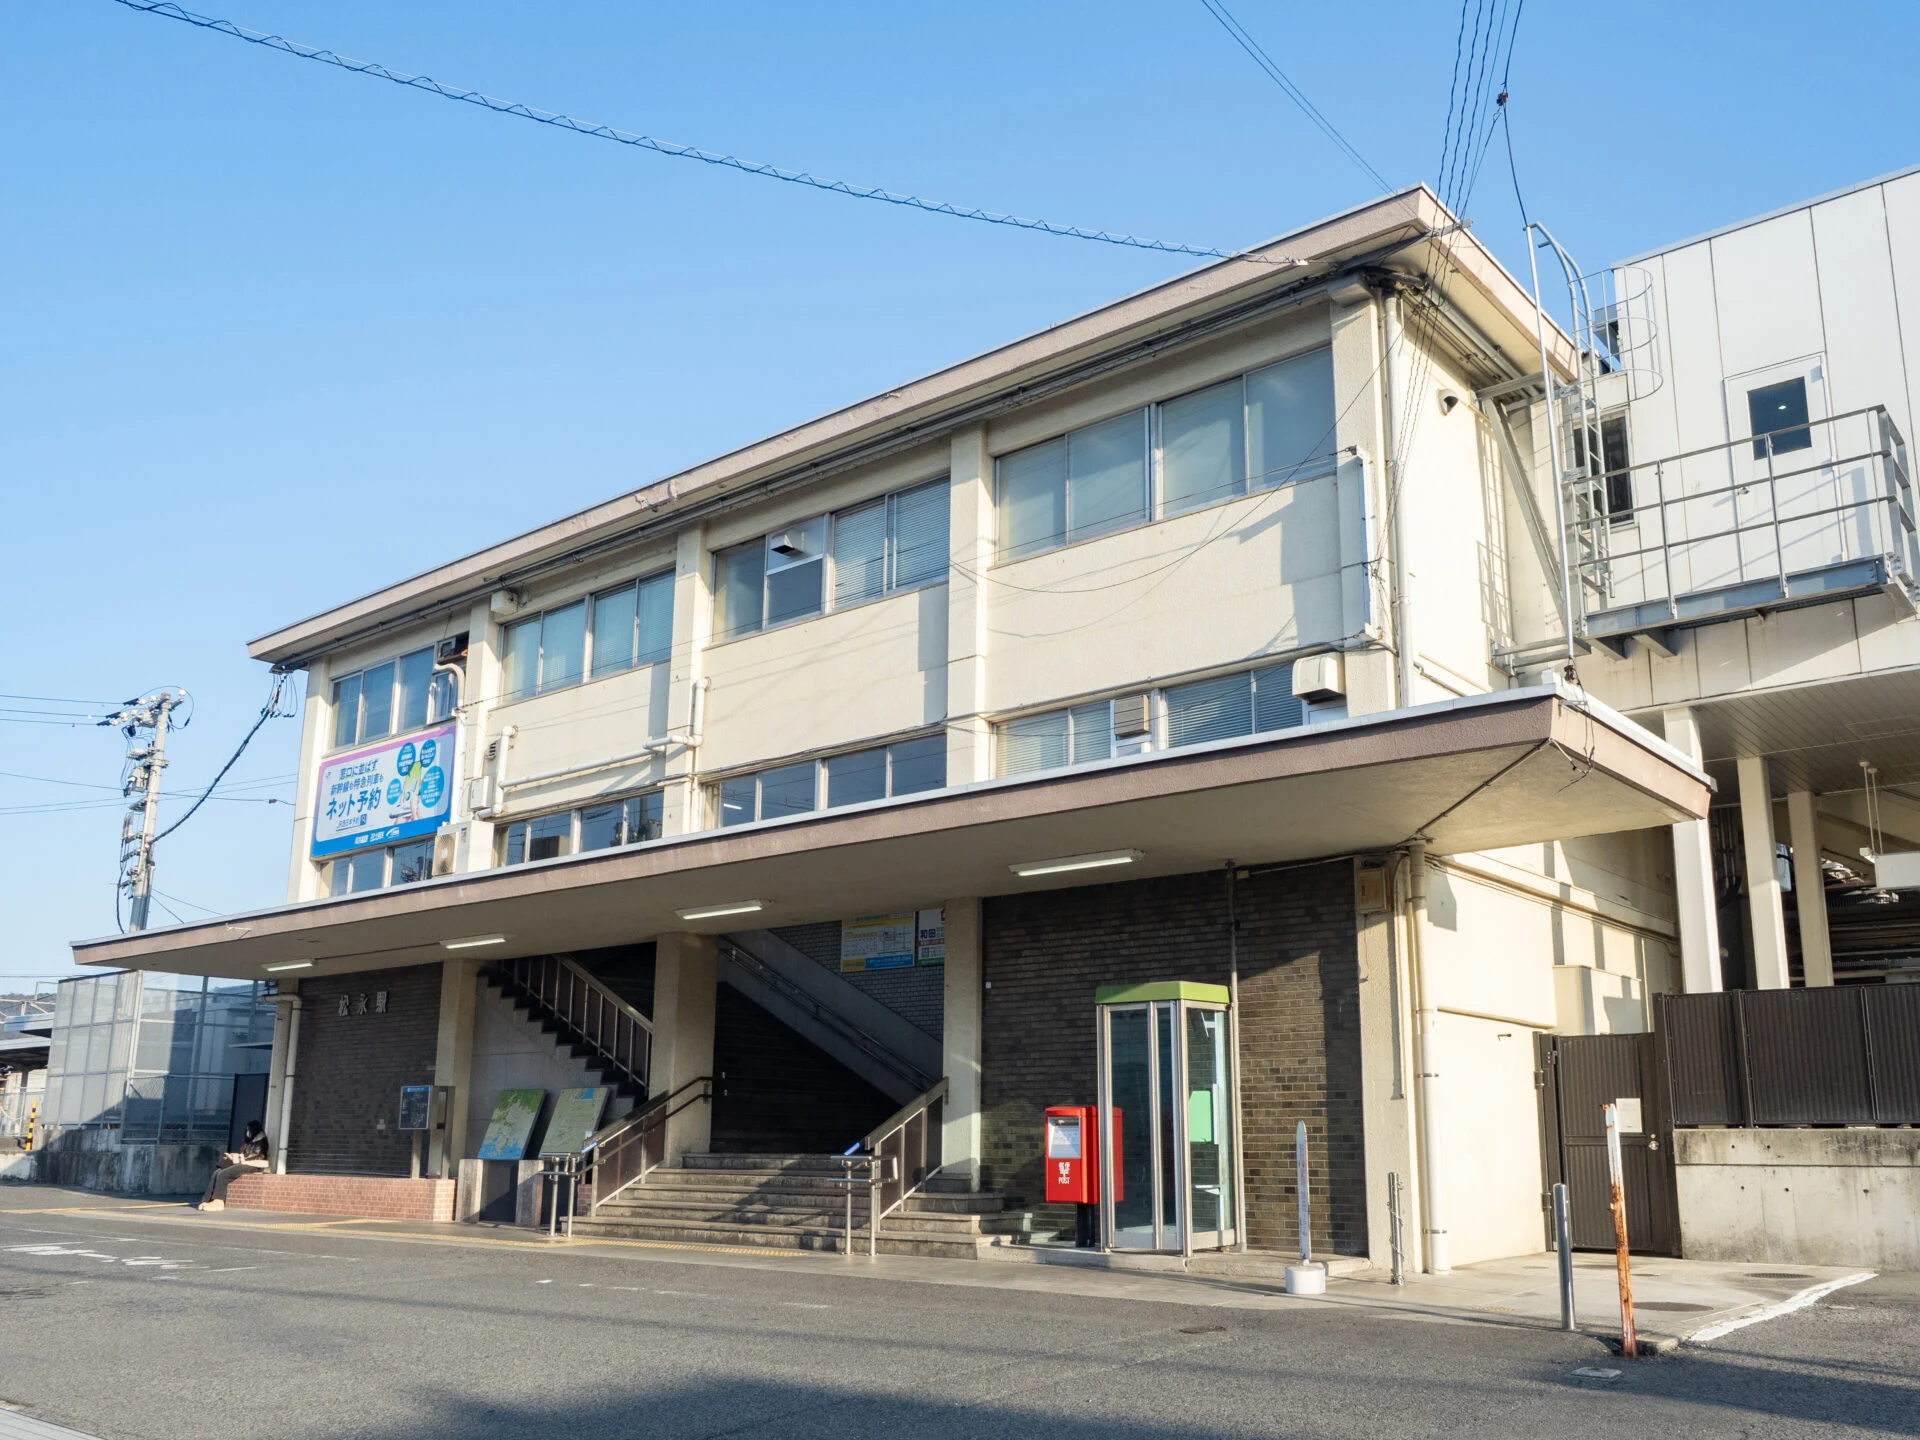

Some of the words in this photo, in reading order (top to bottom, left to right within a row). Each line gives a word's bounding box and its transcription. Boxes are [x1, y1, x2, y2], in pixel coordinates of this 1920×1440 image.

[331, 773, 383, 796] 新幹線も特急列車も
[326, 787, 382, 820] ネット予約
[339, 991, 387, 1016] 松永駅
[1058, 1177, 1070, 1185] POST
